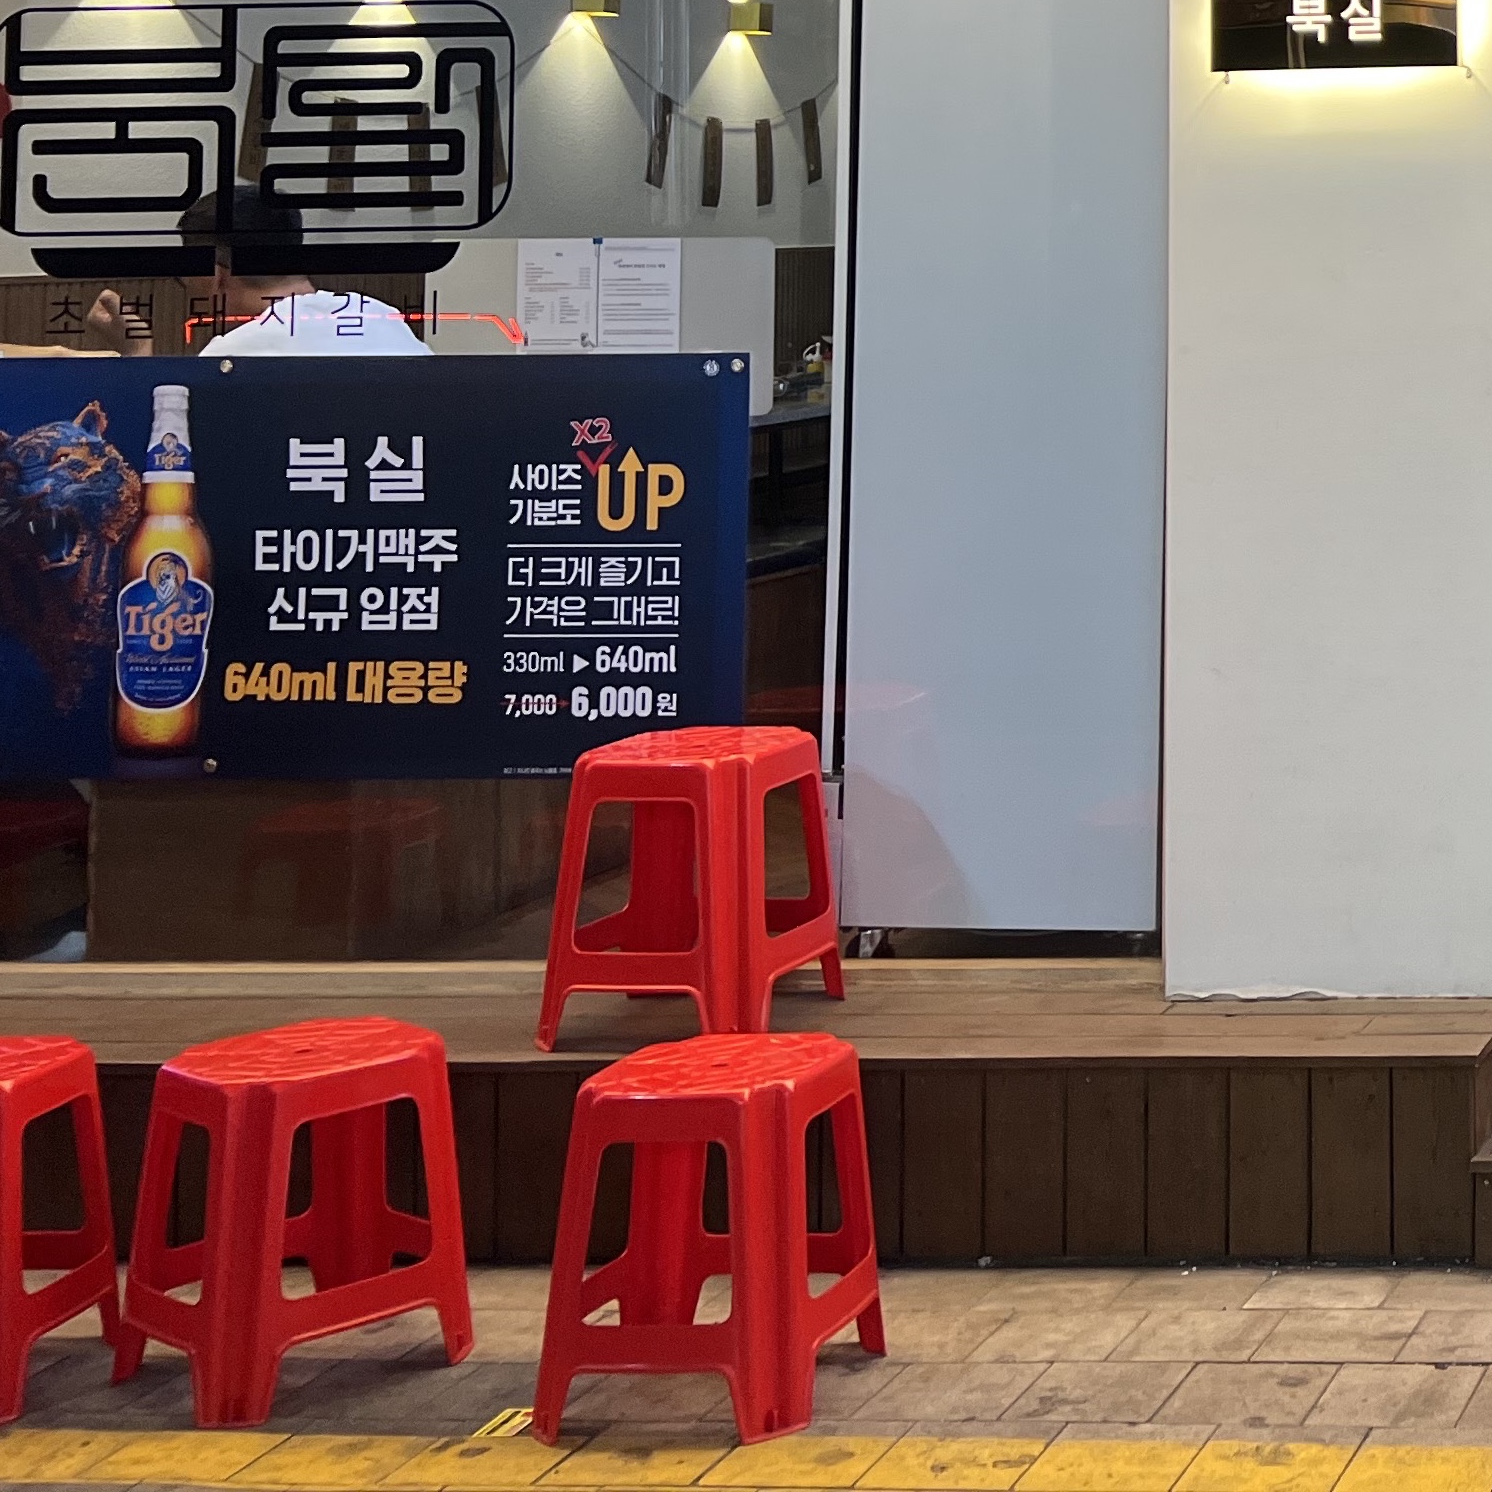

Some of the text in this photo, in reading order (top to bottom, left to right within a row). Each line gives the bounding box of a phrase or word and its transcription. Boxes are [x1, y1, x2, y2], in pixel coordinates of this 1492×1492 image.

[509, 448, 685, 532] 사이즈 UP
[508, 499, 581, 526] 기분도
[254, 528, 458, 573] 타이거맥주
[507, 556, 681, 587] 더 크게 즐기고
[124, 601, 208, 652] Tiger
[267, 586, 440, 632] 신규 입점
[505, 595, 680, 627] 가격은 그대로!
[502, 644, 677, 673] 330ml 640ml
[223, 661, 337, 702] 640ml
[346, 660, 468, 704] 대용량
[503, 693, 557, 718] 7,000
